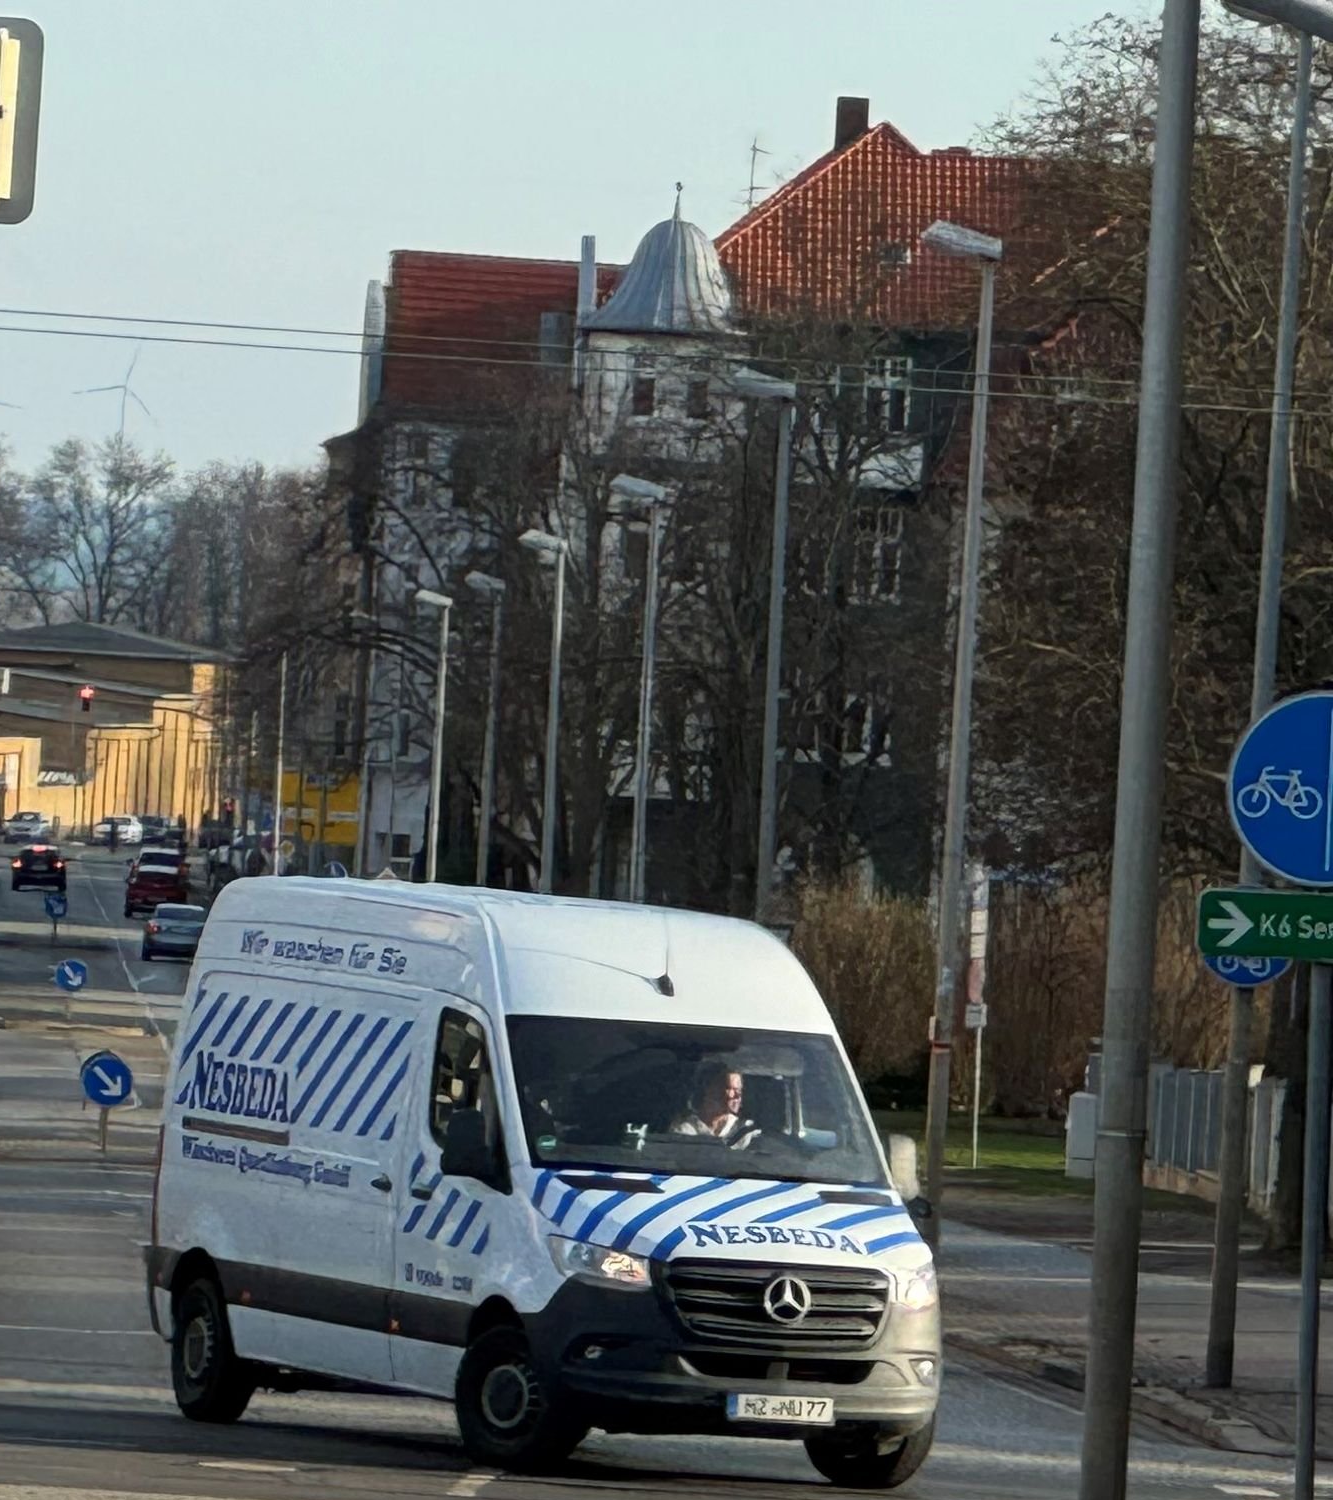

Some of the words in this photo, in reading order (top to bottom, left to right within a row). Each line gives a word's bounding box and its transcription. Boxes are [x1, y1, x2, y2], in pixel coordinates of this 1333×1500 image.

[1259, 913, 1292, 937] K6
[1297, 914, 1333, 939] Se
[189, 1050, 290, 1123] NESBEDA
[688, 1224, 863, 1255] NESBEDA
